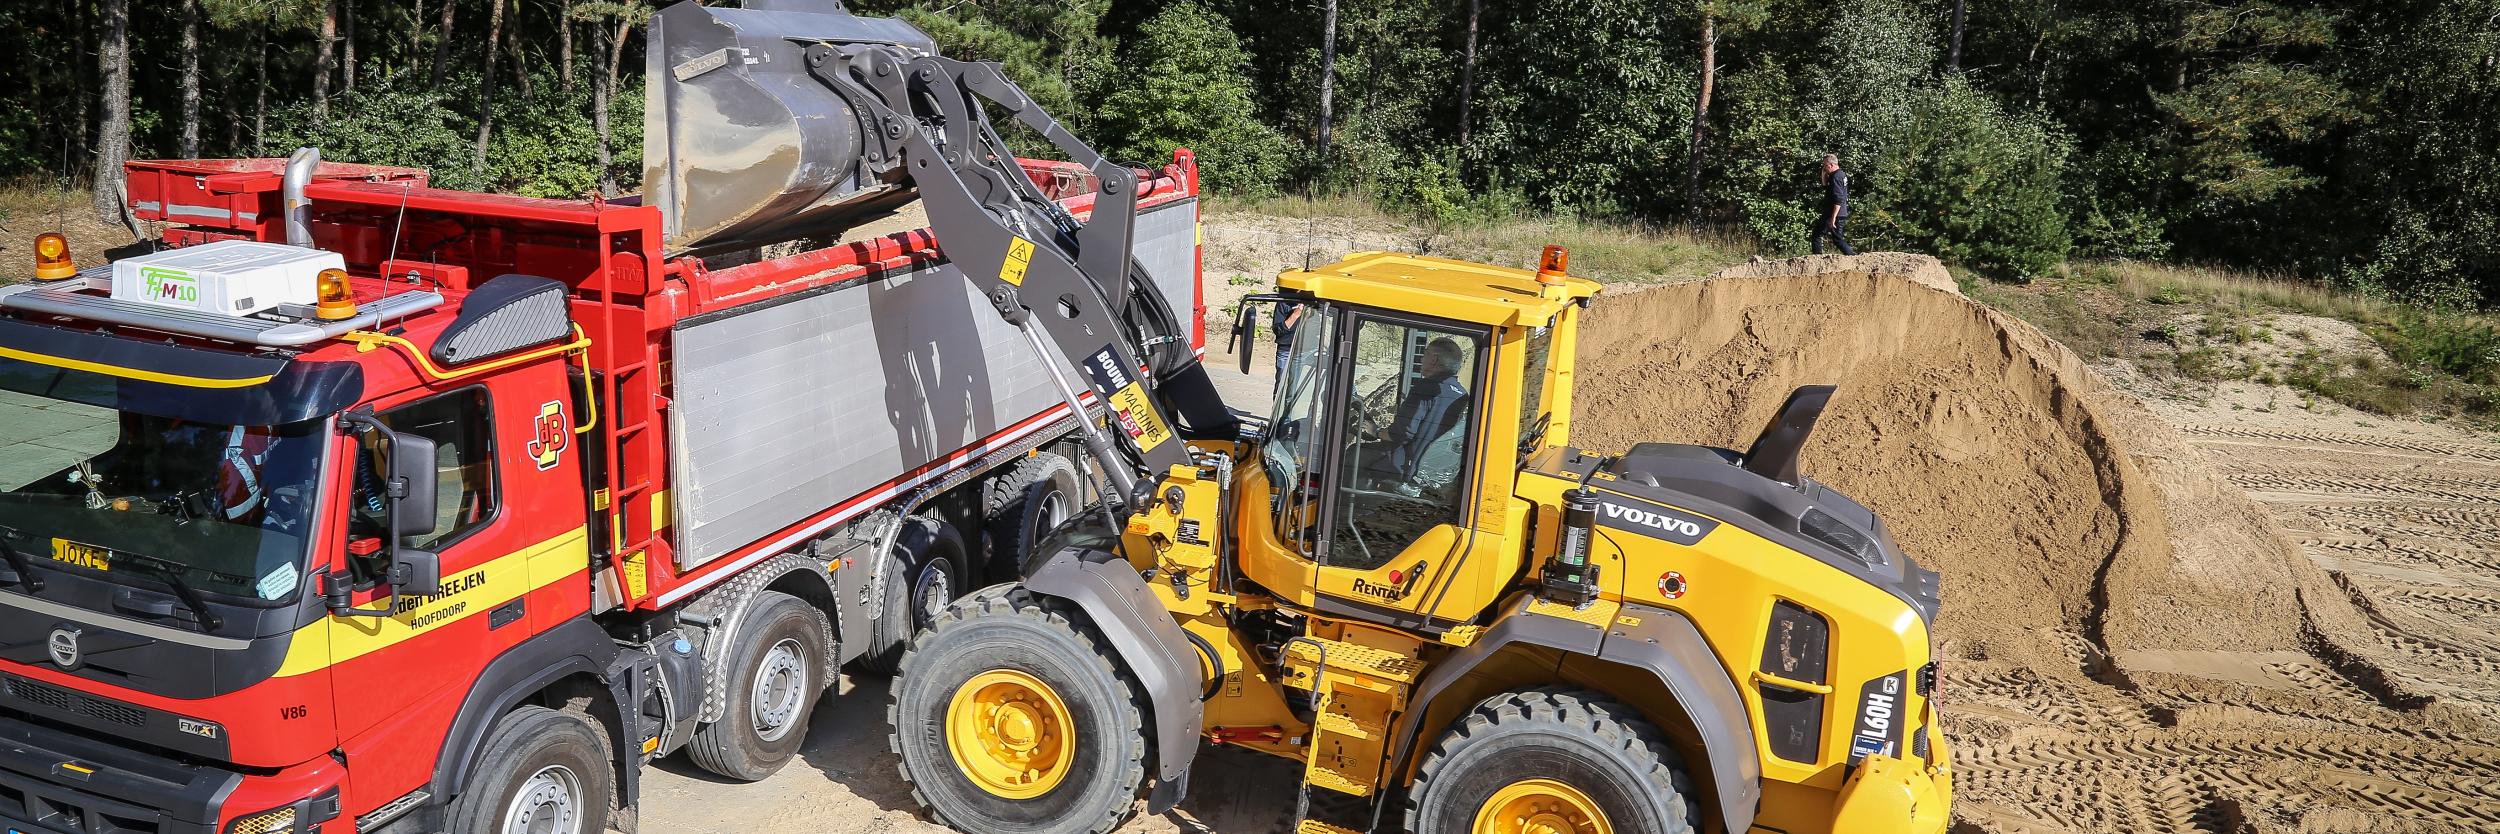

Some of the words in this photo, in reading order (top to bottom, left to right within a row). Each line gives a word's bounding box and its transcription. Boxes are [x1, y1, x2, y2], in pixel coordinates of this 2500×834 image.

[1096, 350, 1128, 389] BOUW
[1120, 387, 1162, 443] MACHINES
[1122, 410, 1140, 434] TEST
[1602, 502, 1700, 537] VOLVO
[59, 543, 100, 568] JOKE
[1352, 577, 1401, 601] RENTAL
[410, 601, 467, 630] HOOFDDORP
[51, 642, 76, 653] VOLVO
[280, 704, 307, 720] V86
[1861, 693, 1894, 739] L60H
